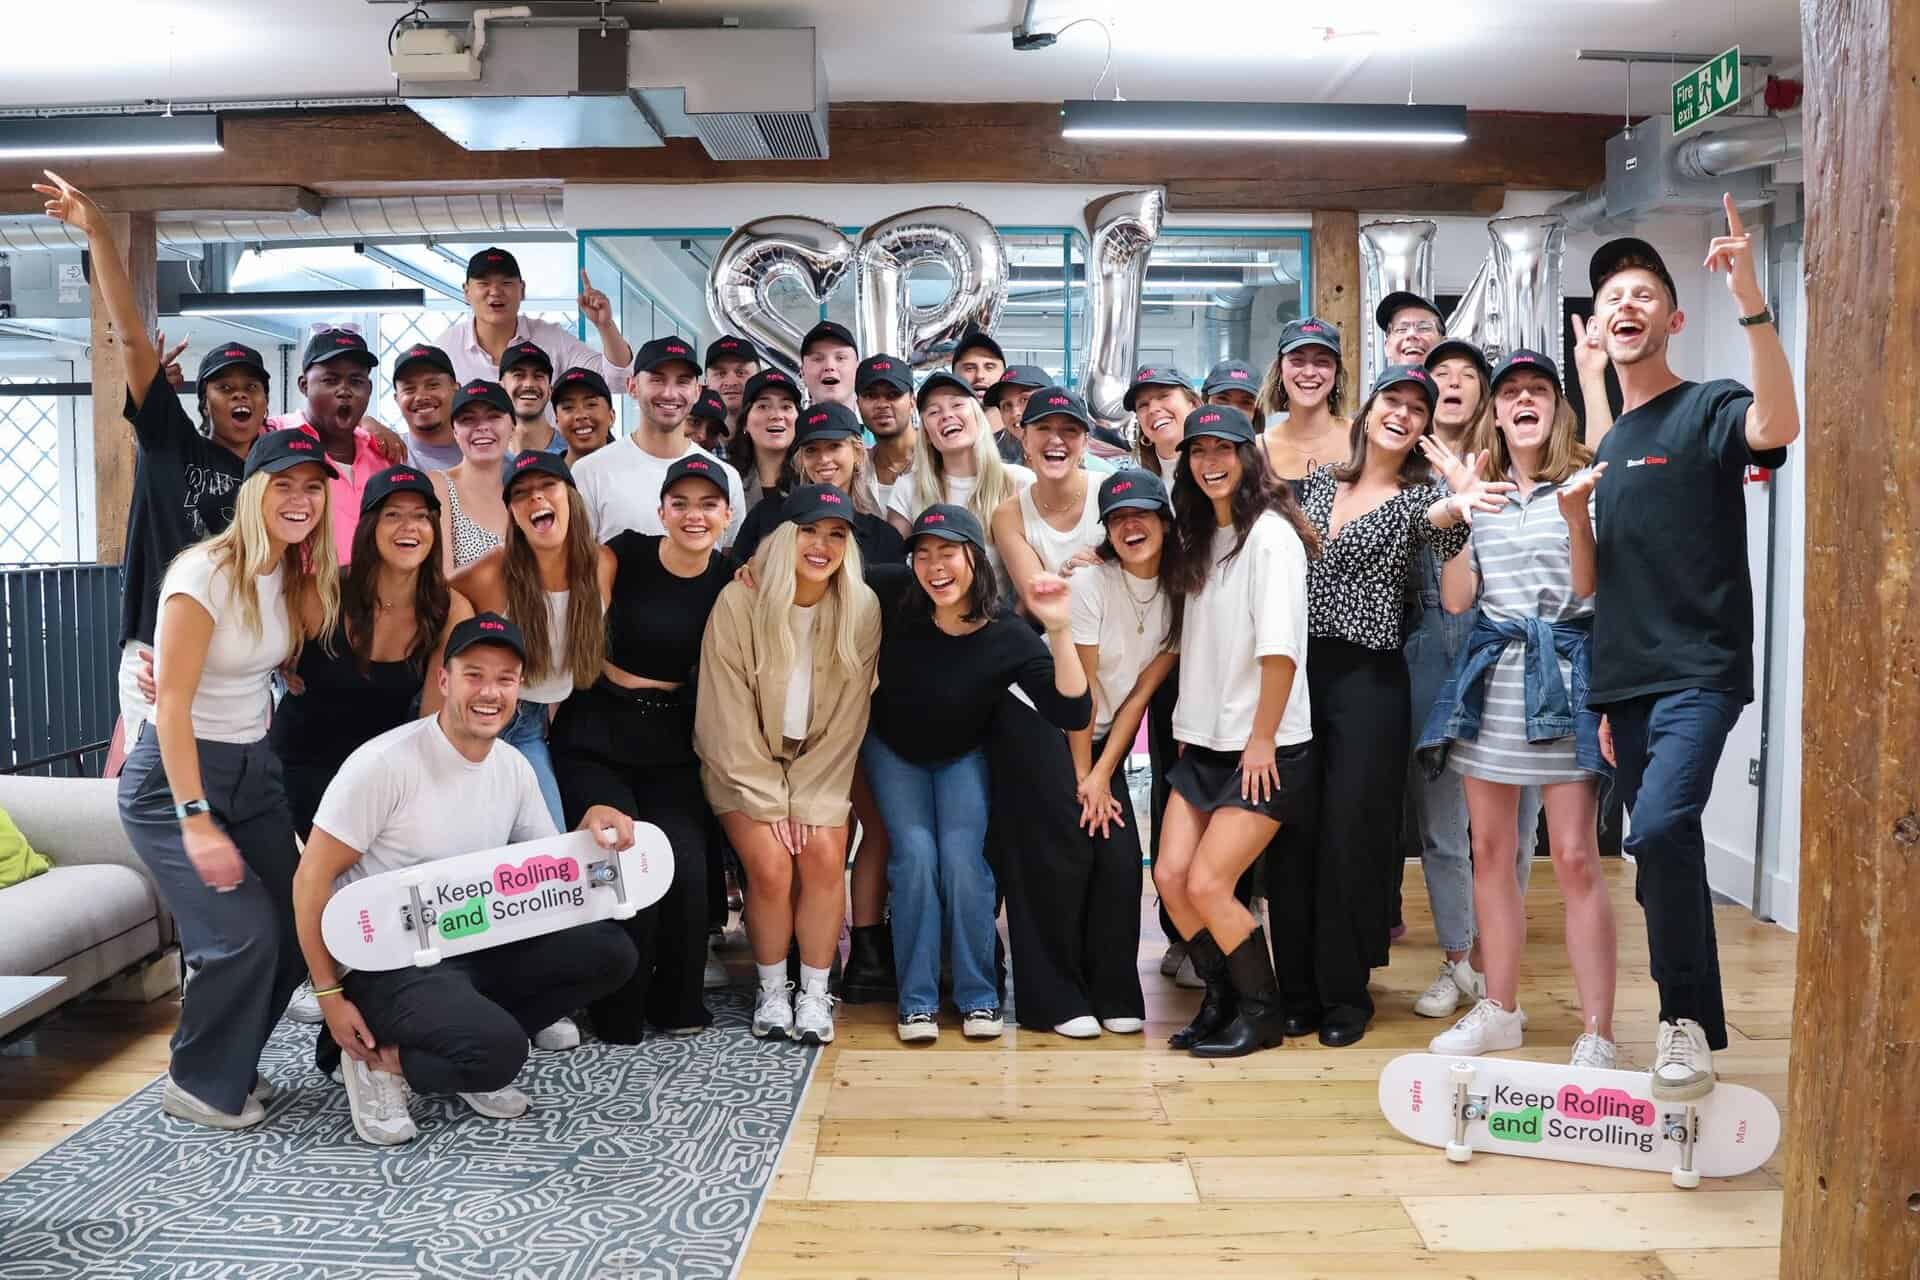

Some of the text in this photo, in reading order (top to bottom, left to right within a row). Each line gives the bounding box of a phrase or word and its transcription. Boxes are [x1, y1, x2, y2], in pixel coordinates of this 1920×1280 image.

[1676, 85, 1694, 105] Fire
[1678, 102, 1694, 125] exit
[1048, 396, 1069, 407] spin
[1199, 413, 1221, 424] spin
[820, 493, 841, 504] spin
[1112, 481, 1133, 494] spin
[924, 514, 945, 525] spin
[436, 861, 569, 905] Keep Rolling
[442, 886, 585, 933] and Scrolling
[357, 910, 375, 943] spin
[1409, 1080, 1423, 1112] spin
[1495, 1084, 1646, 1125] Keep Rolling
[1492, 1116, 1654, 1152] and Scrolling
[1735, 1119, 1746, 1144] Max
